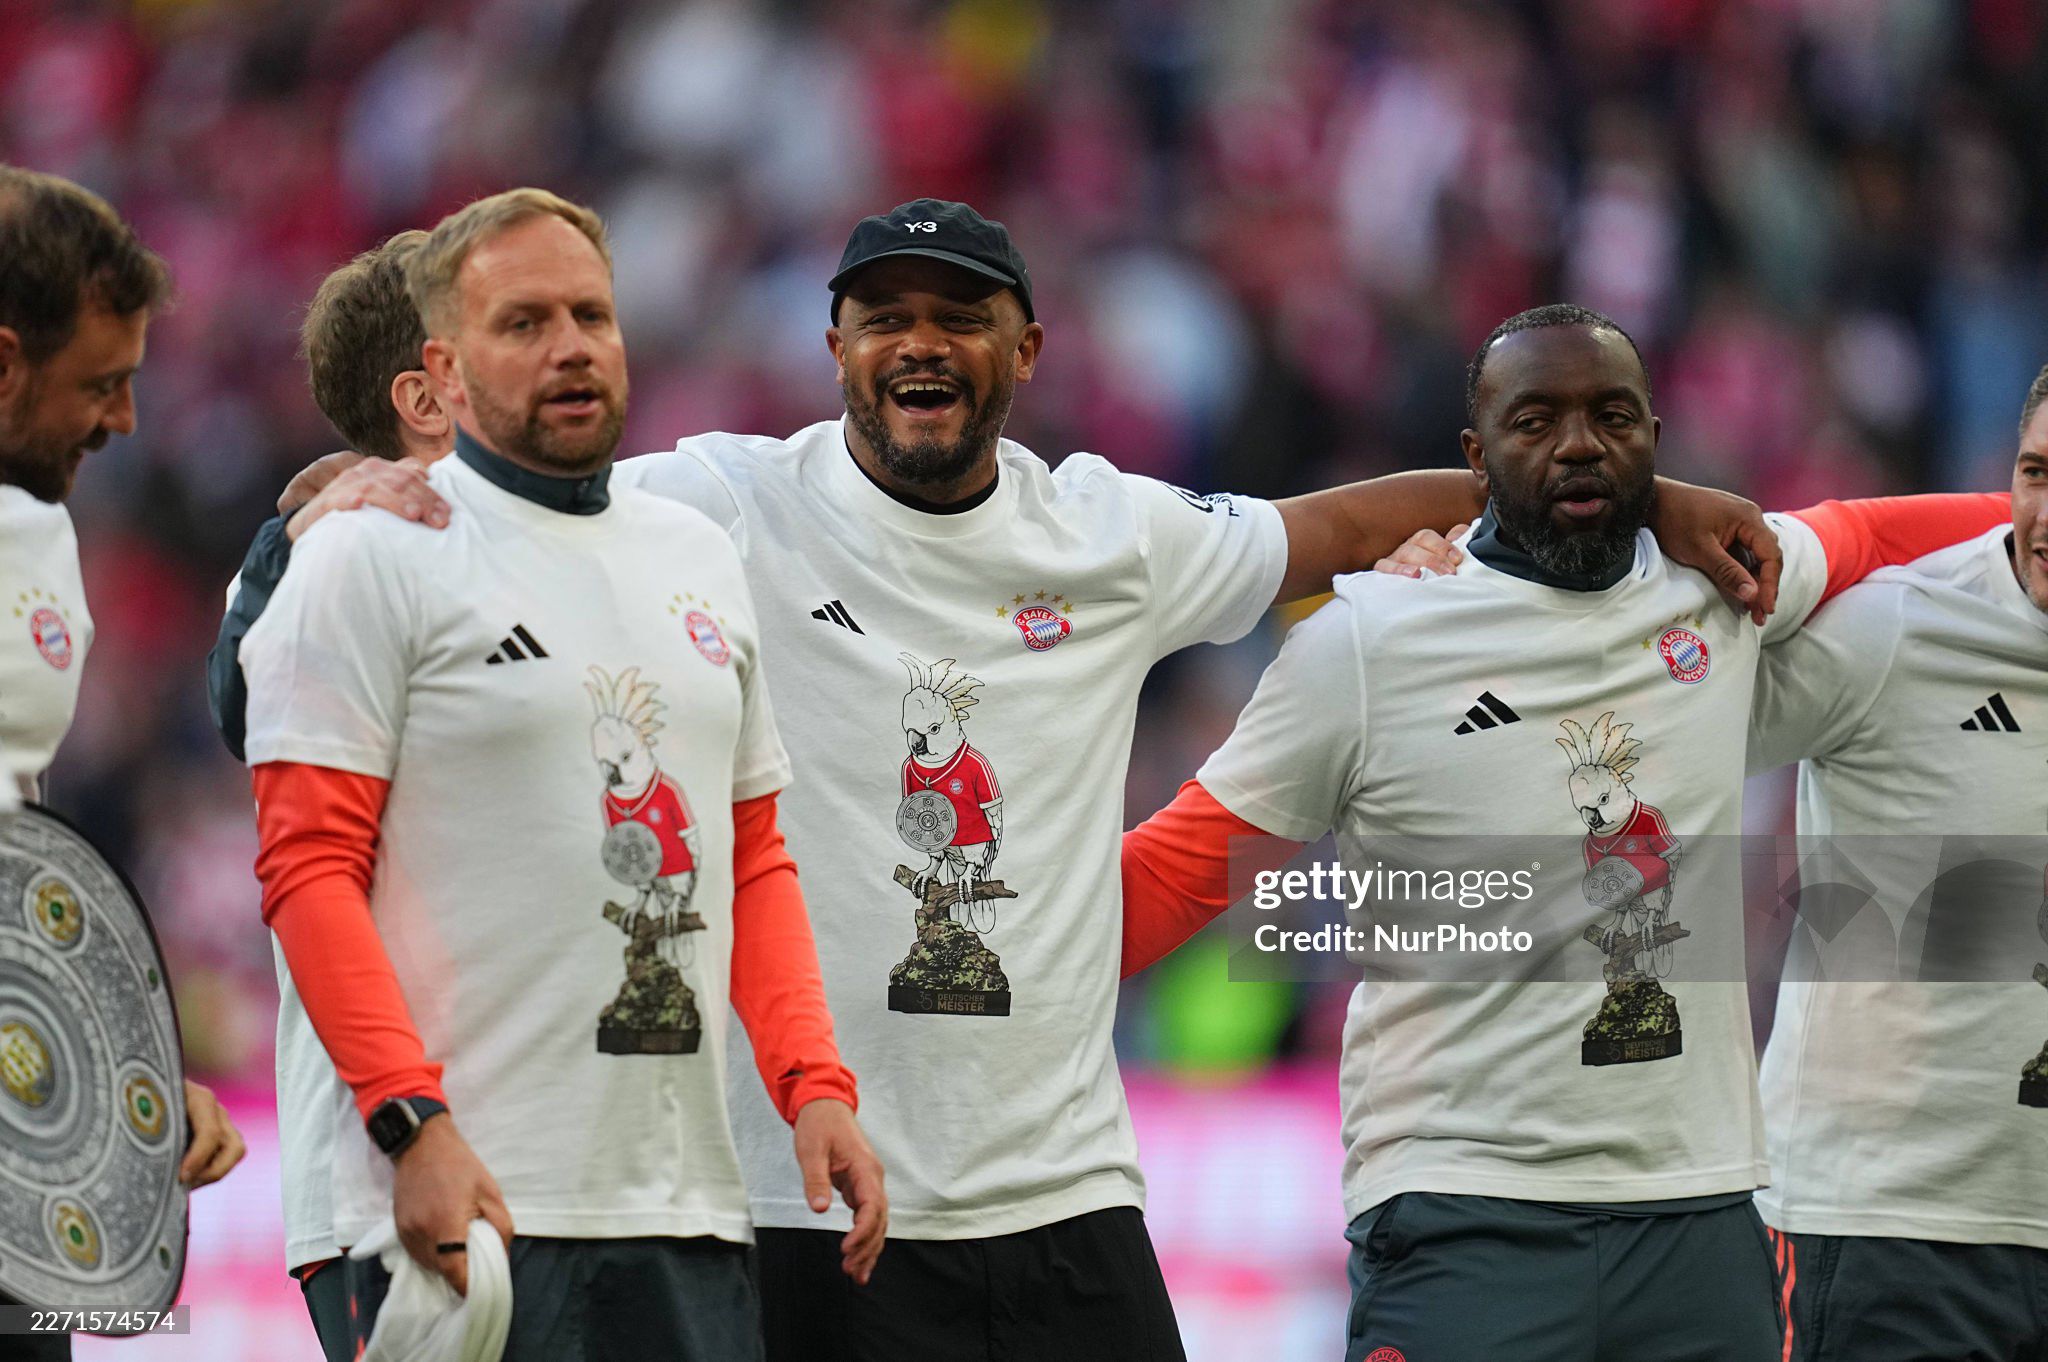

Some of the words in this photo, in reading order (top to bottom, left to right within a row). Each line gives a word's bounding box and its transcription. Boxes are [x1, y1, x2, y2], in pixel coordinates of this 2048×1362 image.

[904, 221, 938, 233] Y-3
[1663, 632, 1702, 647] BAYERN
[937, 993, 985, 1002] DEUTSCHER
[937, 1000, 985, 1012] MEISTER
[1624, 1048, 1667, 1060] MEISTER
